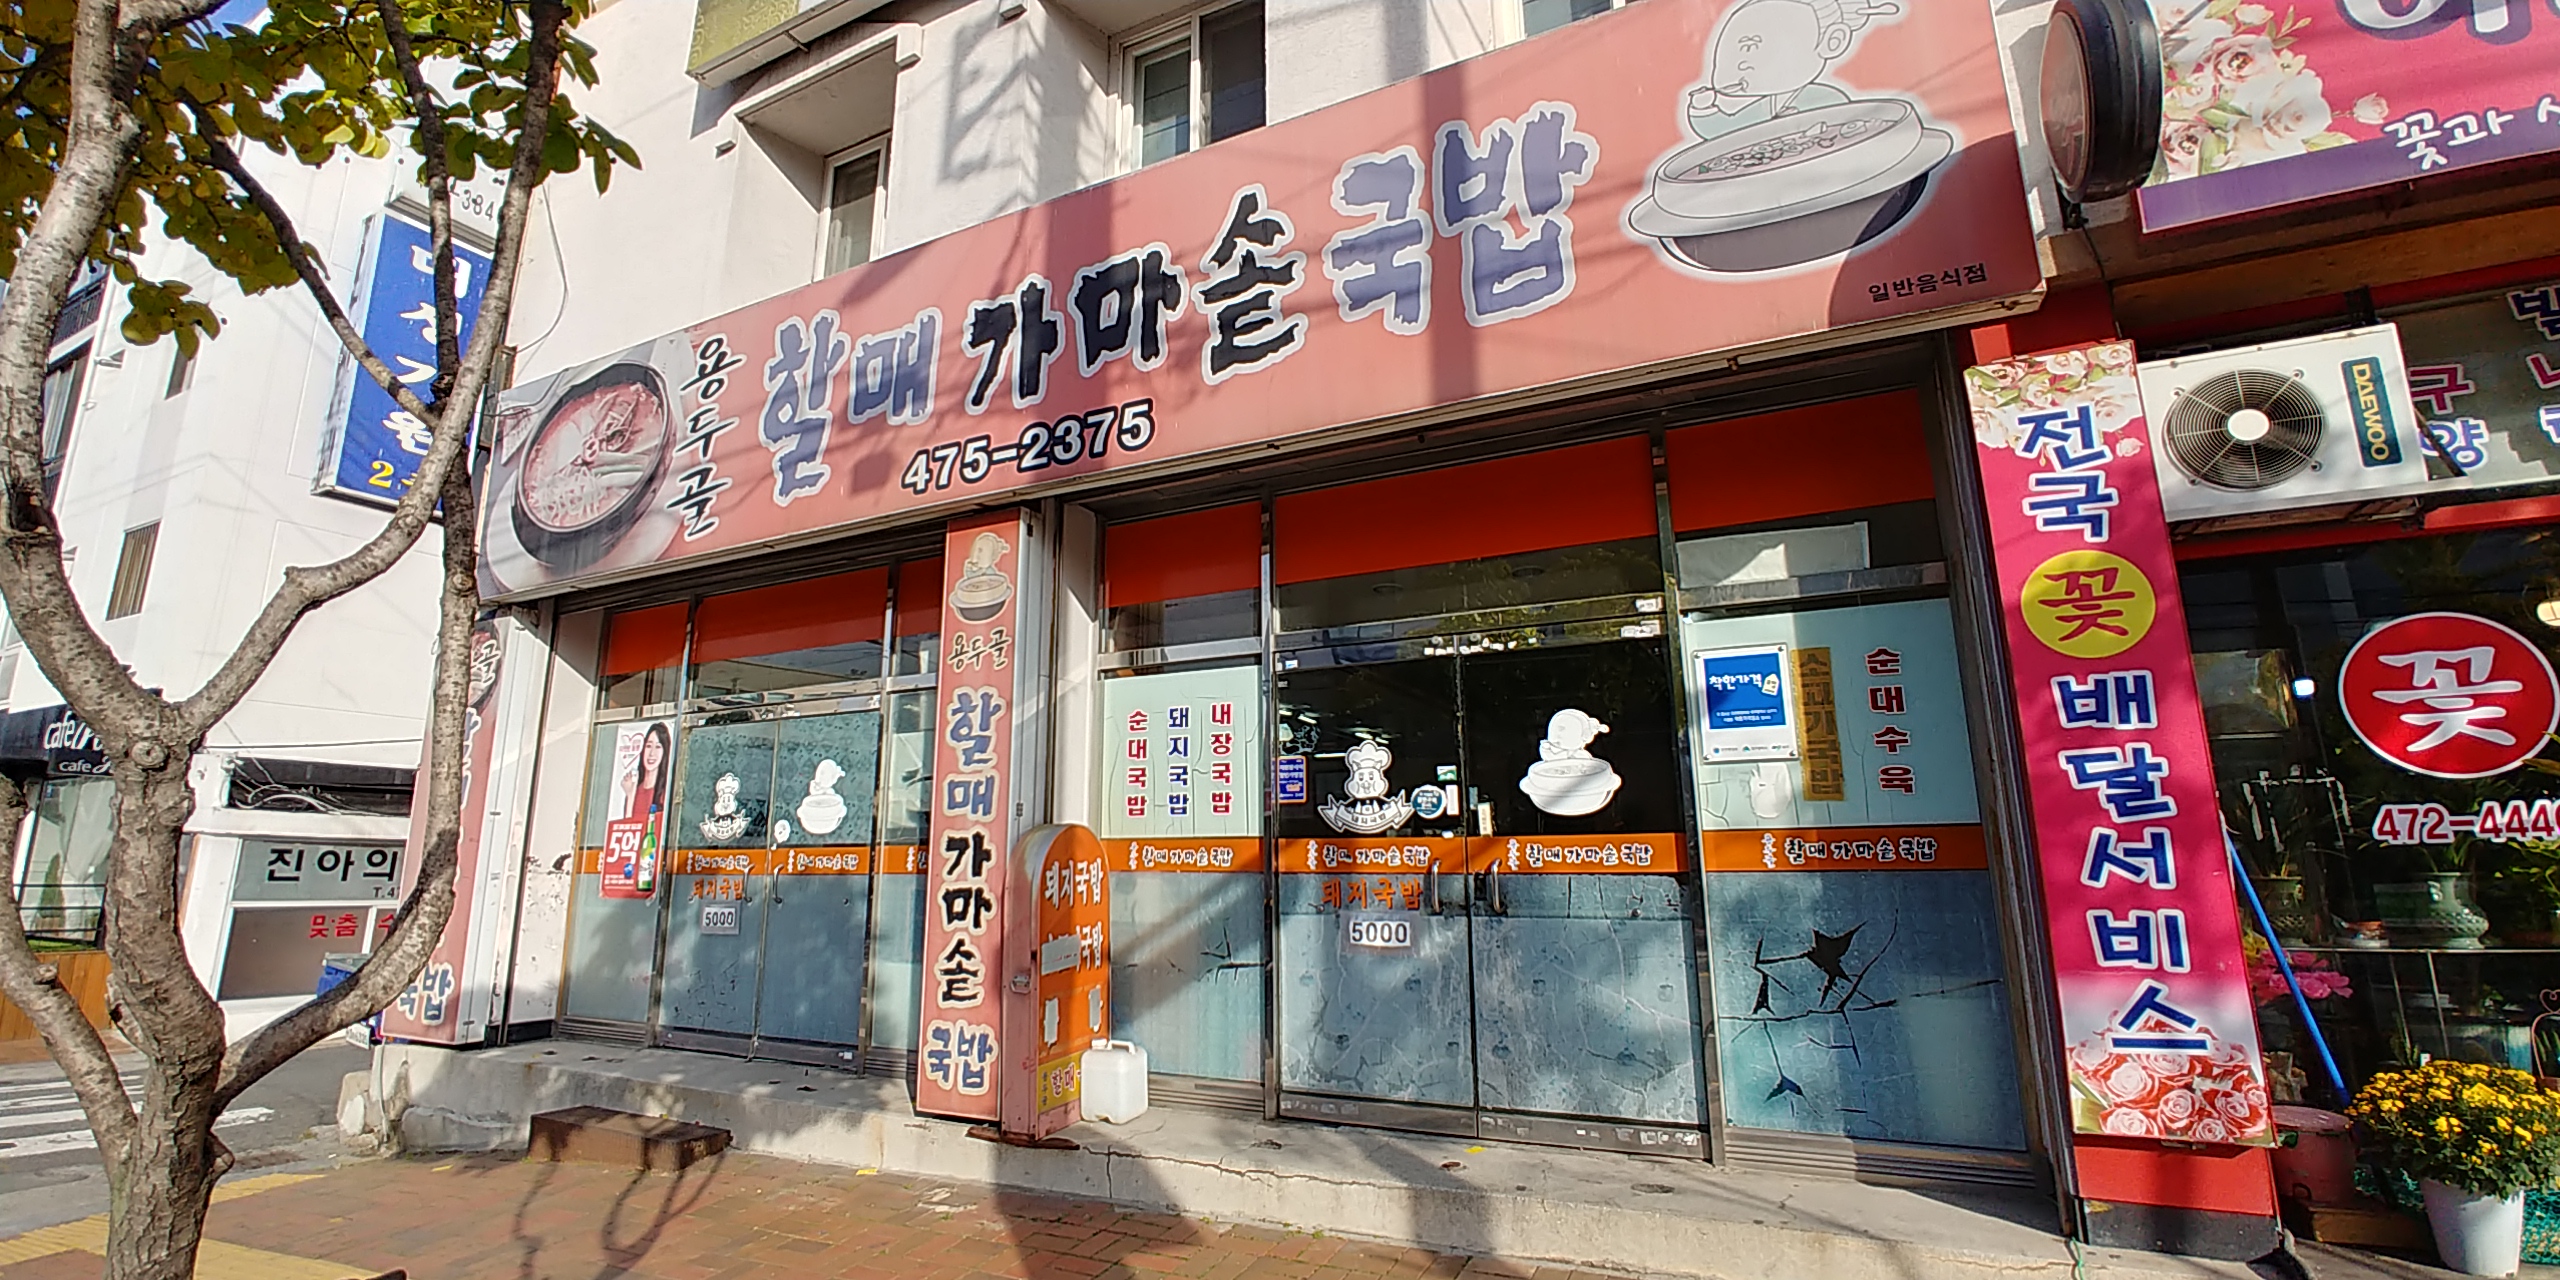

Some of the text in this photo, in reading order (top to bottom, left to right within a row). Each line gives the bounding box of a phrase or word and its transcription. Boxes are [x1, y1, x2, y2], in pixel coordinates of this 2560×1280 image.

[2382, 110, 2514, 170] 꽃과
[761, 109, 1593, 502] 할매 가마솥 국밥
[1868, 262, 1988, 303] 일반음식점
[667, 334, 746, 541] 용두골
[2351, 363, 2391, 461] DAEWOO
[903, 402, 1155, 491] 475-2375
[948, 627, 1011, 671] 용두골
[1709, 673, 1763, 691] 착한가격
[2372, 646, 2524, 753] 꽃
[1865, 647, 1916, 795] 순대수육
[2016, 404, 2209, 1052] 전국 꽃 배달서비스
[59, 760, 92, 773] cafe
[1127, 709, 1148, 817] 순대국밥
[1168, 706, 1190, 816] 돼지국밥
[1210, 703, 1233, 814] 내장국밥
[266, 848, 398, 882] 진아의
[606, 831, 641, 865] 5억
[1210, 848, 1233, 867] 국밥
[1526, 842, 1654, 868] 할매 가마솥 국밥
[1784, 836, 1938, 865] 할매 가마솥 국밥
[928, 690, 1001, 1091] 할매 가마솥 국밥
[1044, 857, 1104, 909] 돼지국밥
[1321, 877, 1424, 910] 돼지국밥
[704, 910, 734, 927] 5000
[1351, 921, 1409, 944] 5000
